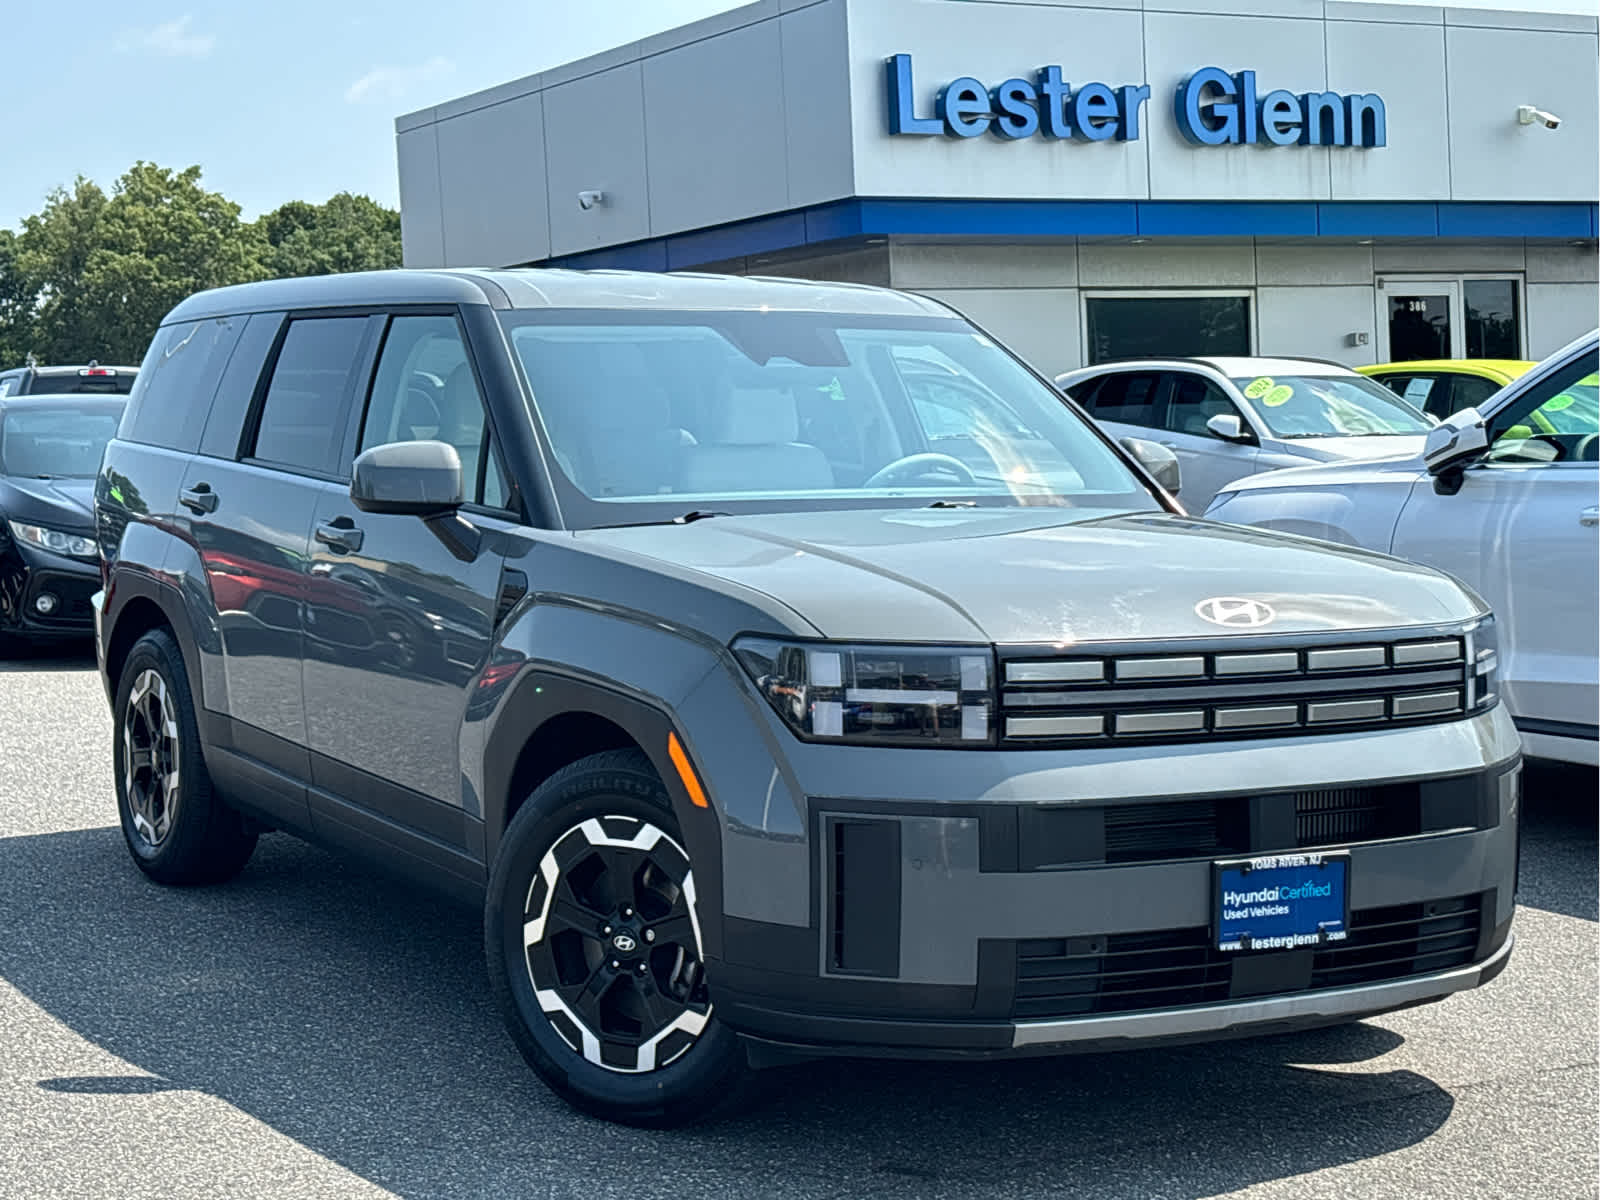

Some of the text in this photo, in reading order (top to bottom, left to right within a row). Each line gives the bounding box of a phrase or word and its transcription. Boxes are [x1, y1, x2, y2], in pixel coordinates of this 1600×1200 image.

[886, 54, 1387, 147] Lester Glenn
[1251, 858, 1277, 870] TOMS
[1309, 854, 1322, 865] NJ
[1223, 904, 1289, 920] Used Vehicles
[1251, 933, 1319, 950] lesterglenn
